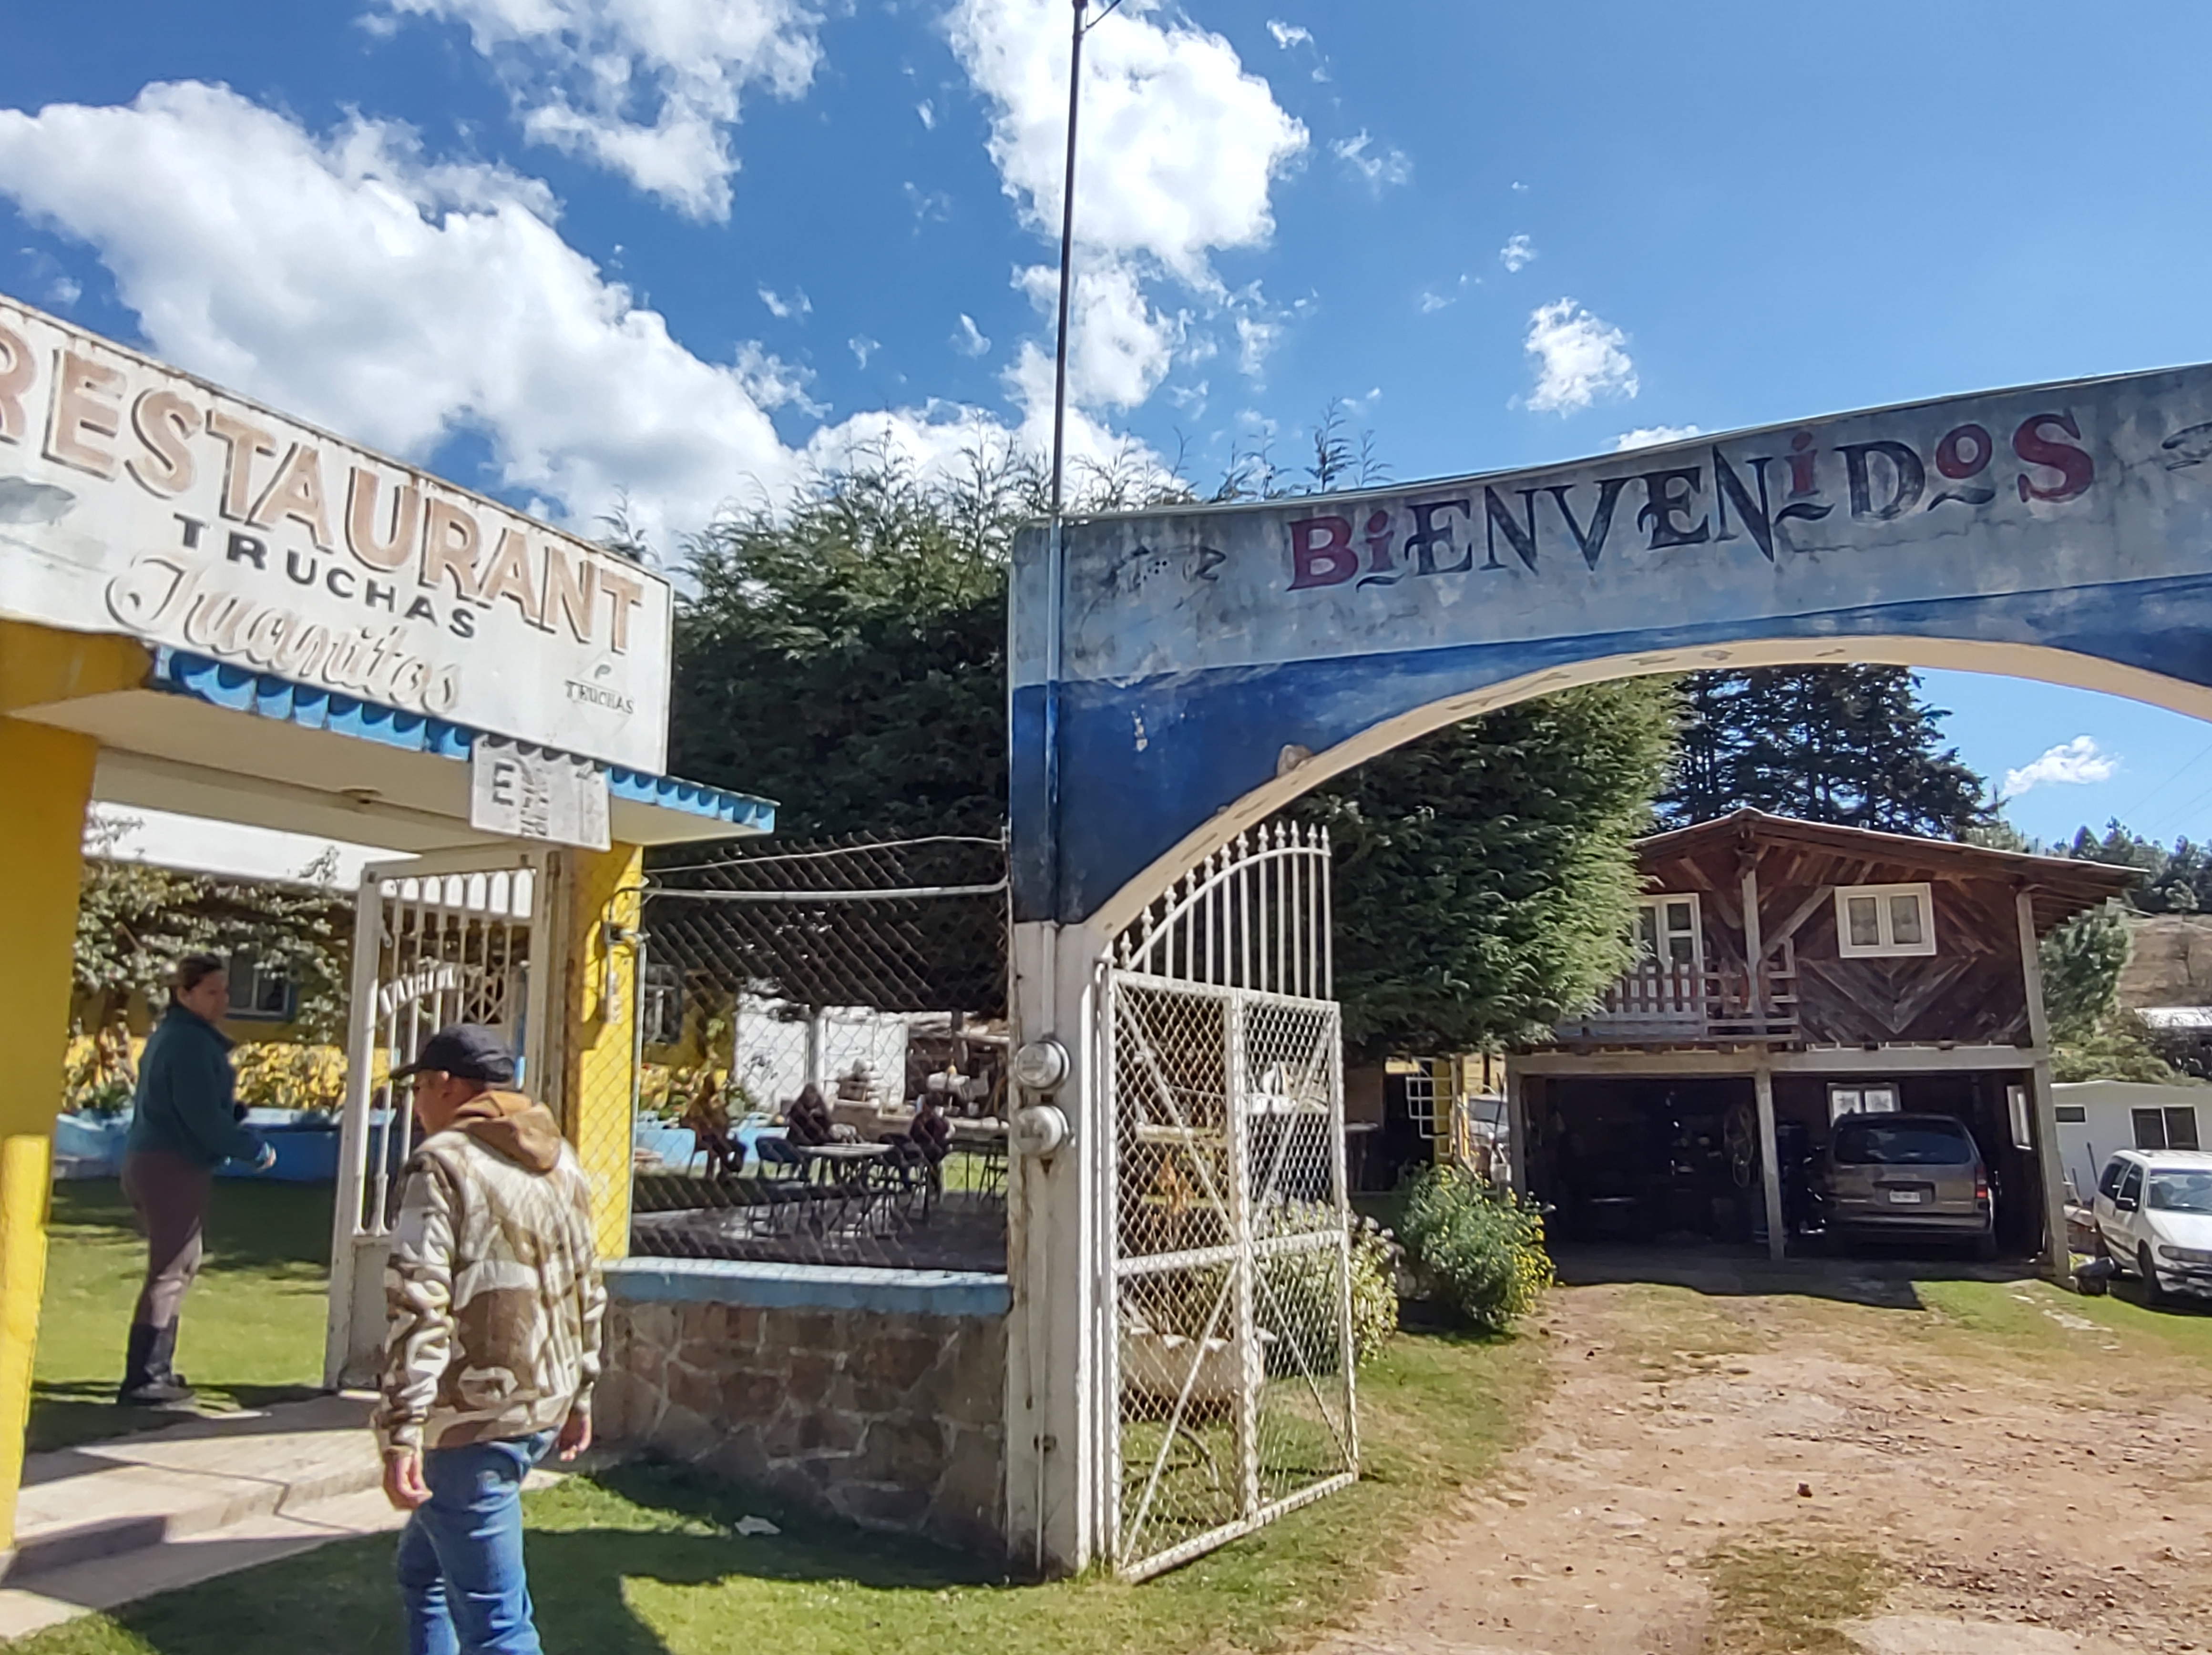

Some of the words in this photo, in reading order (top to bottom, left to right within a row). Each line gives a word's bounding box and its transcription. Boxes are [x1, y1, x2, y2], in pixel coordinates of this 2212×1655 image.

[104, 552, 463, 715] Juanitos
[173, 512, 476, 639] TRUCHAS
[564, 679, 634, 715] TRUCHAS
